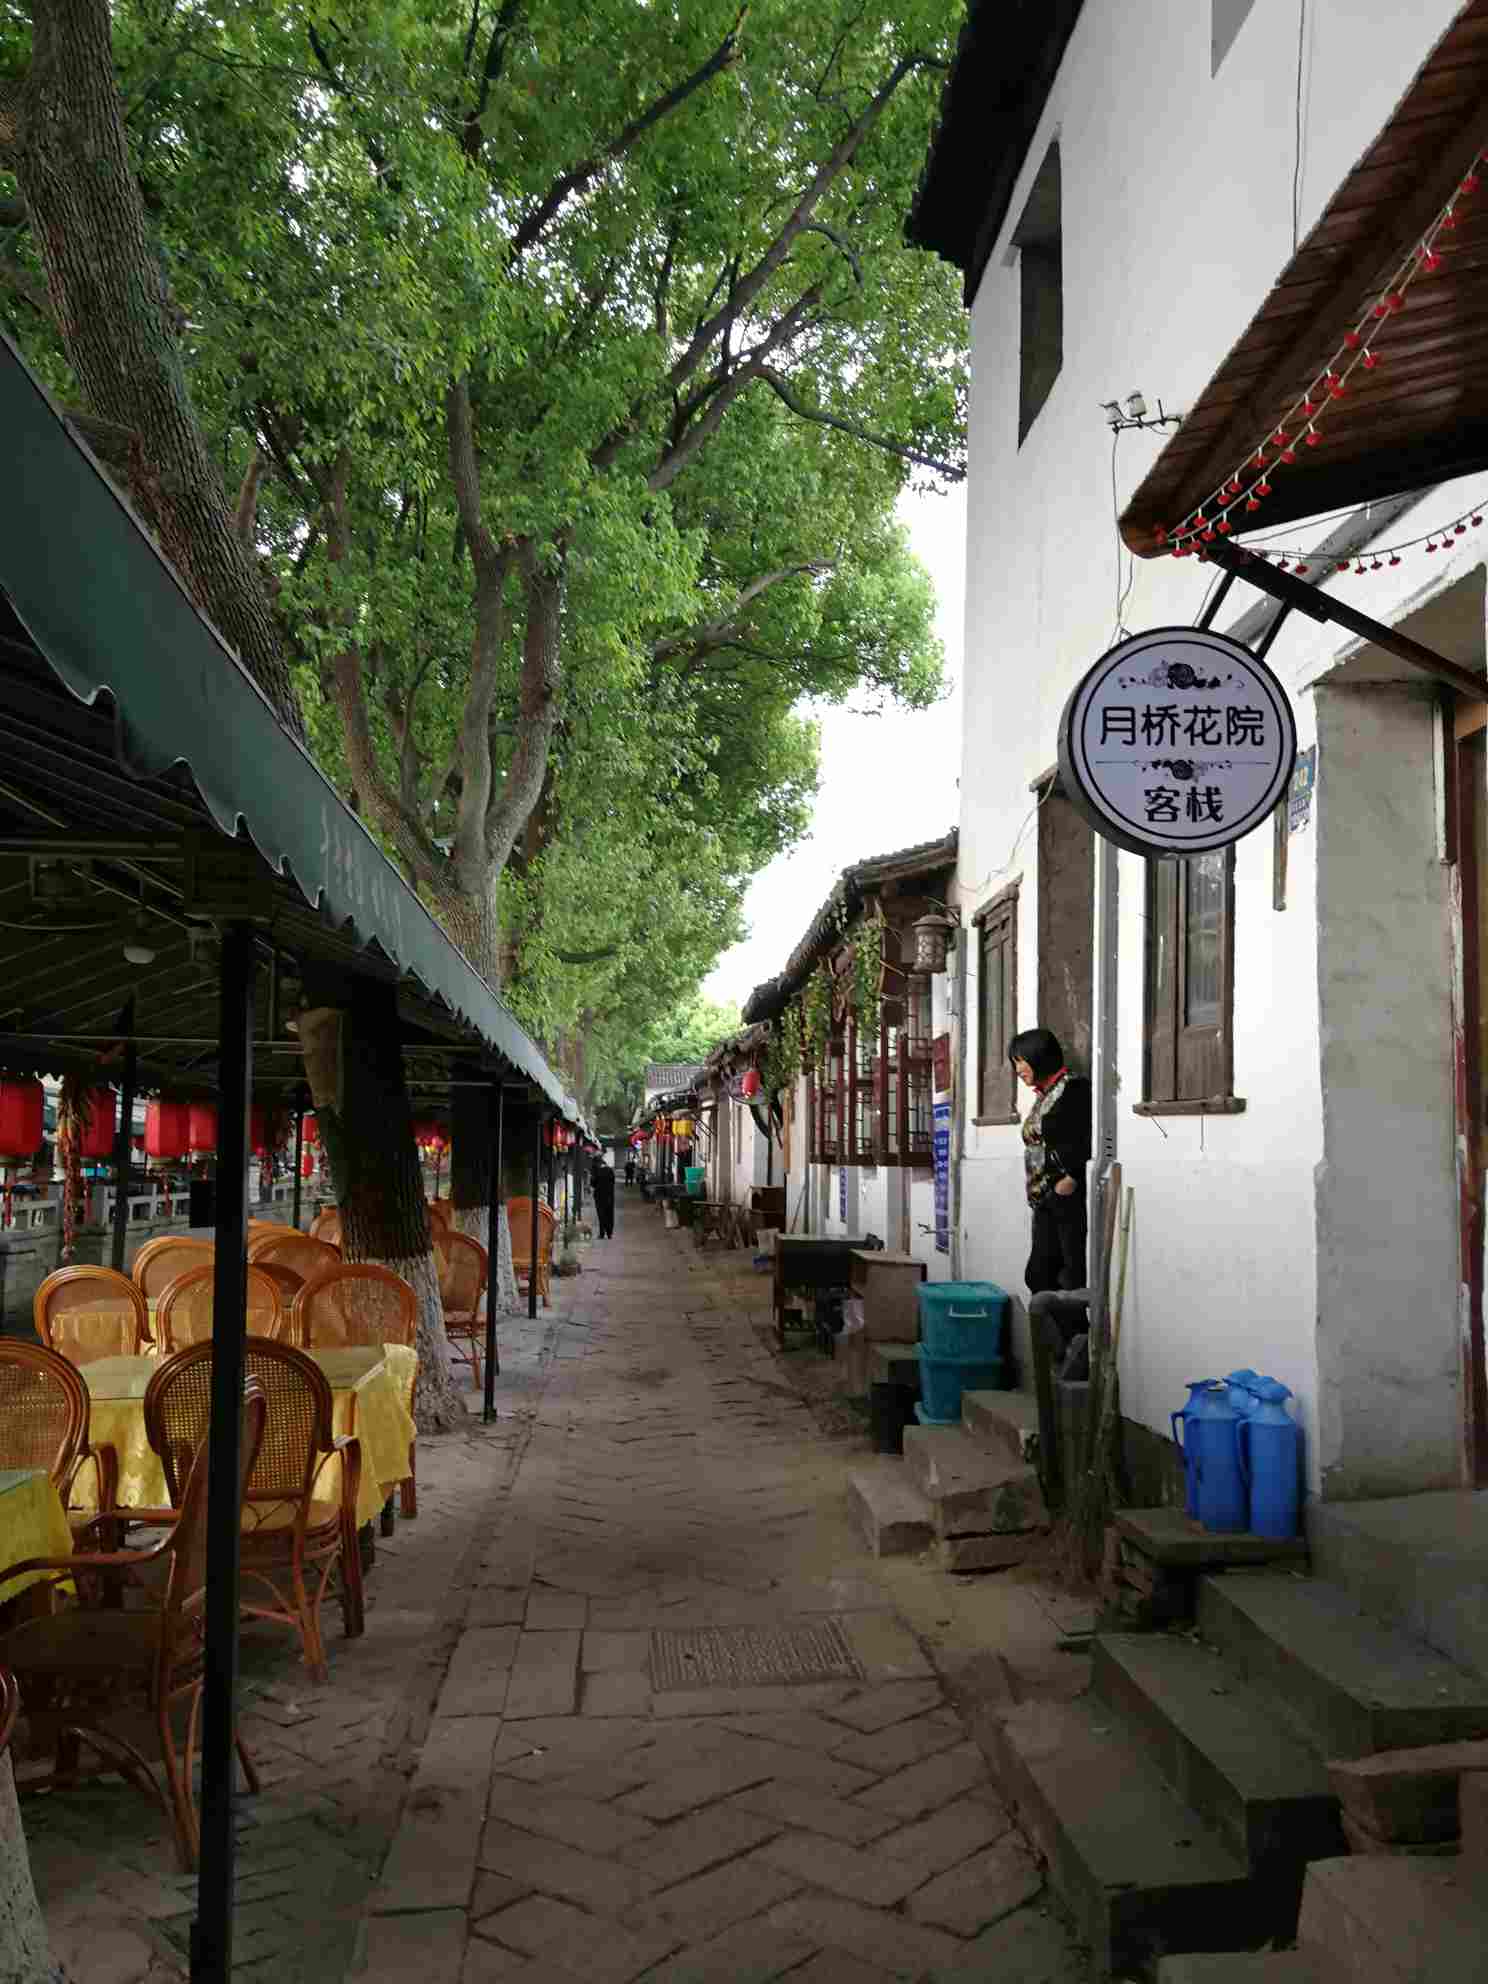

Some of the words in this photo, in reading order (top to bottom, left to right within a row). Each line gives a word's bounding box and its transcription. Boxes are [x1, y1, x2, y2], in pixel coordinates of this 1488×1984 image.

[1100, 704, 1265, 747] 月桥花院
[1143, 785, 1224, 823] 客栈
